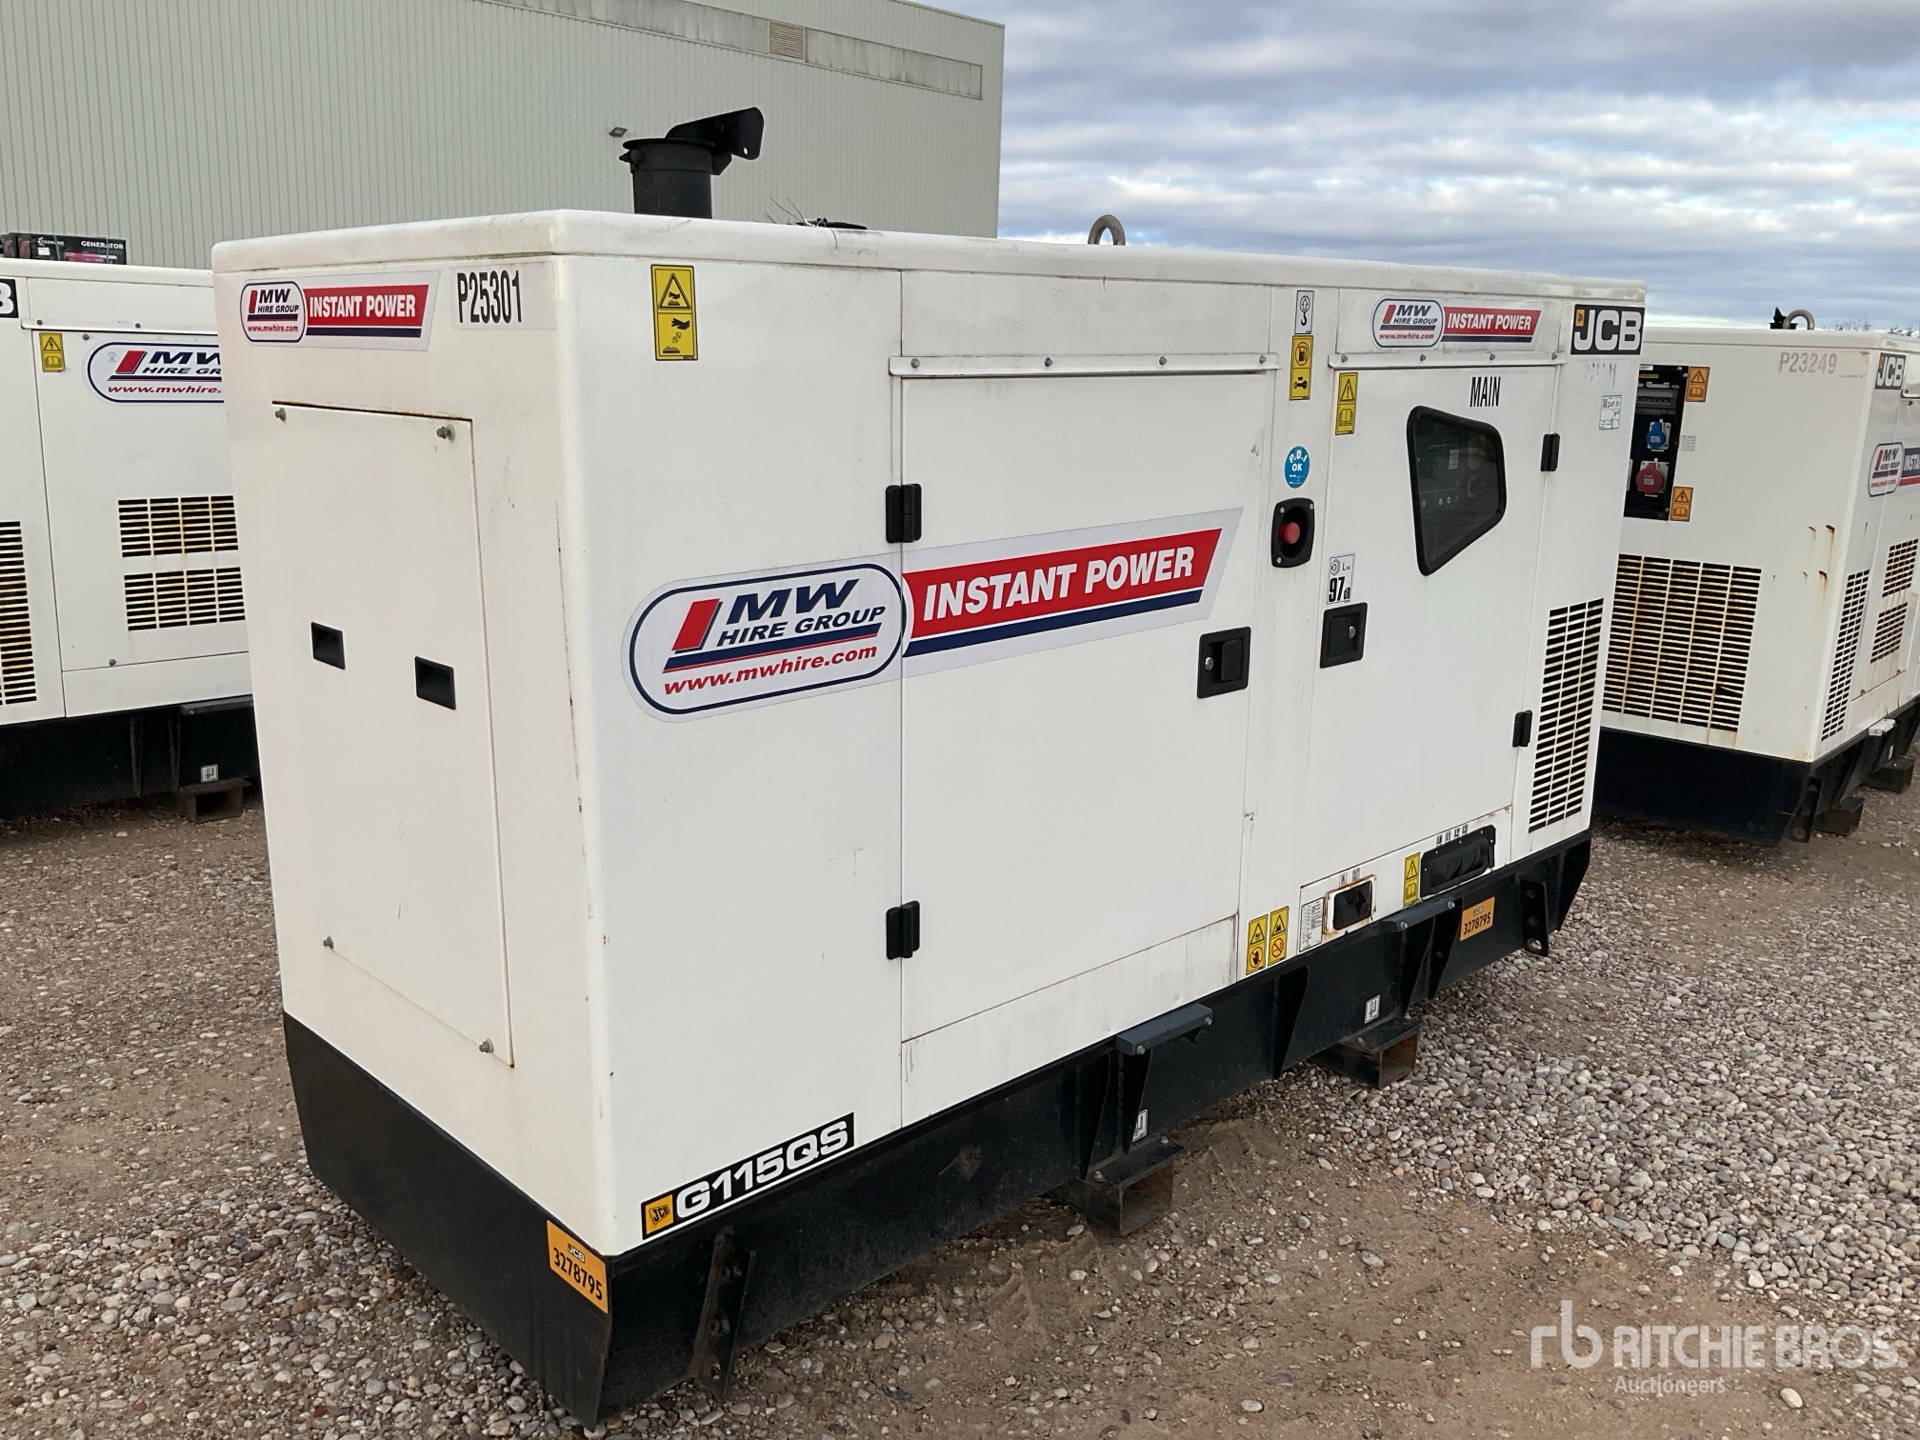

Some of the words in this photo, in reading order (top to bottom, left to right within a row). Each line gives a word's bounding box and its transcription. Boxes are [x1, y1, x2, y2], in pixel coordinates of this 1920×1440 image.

[81, 241, 124, 250] GENERATOR
[258, 288, 291, 304] MW
[310, 295, 363, 318] INSTANT
[366, 294, 416, 318] POWER
[457, 269, 522, 324] P25301
[257, 305, 273, 314] HIRE
[275, 304, 299, 313] GROUP
[1393, 317, 1413, 325] HIRE
[1396, 304, 1431, 317] MW
[247, 325, 299, 333] www.mwhire.com
[1447, 313, 1494, 330] INSTANT
[1494, 315, 1532, 331] POWER
[1573, 309, 1642, 351] JCB
[1778, 352, 1837, 374] P23249
[1876, 356, 1904, 387] JCB
[1469, 376, 1501, 407] MAIN
[1292, 463, 1302, 471] OK
[923, 564, 1077, 621] INSTANT
[1084, 546, 1194, 594] POWER
[726, 579, 860, 625] MW
[716, 622, 788, 647] HIRE
[794, 606, 886, 634] GROUP
[664, 646, 877, 695] www.mwhire.com
[1463, 911, 1491, 935] 3278795
[676, 1120, 849, 1219] G115QS
[653, 1206, 670, 1222] JCB
[554, 1246, 603, 1301] 3278795
